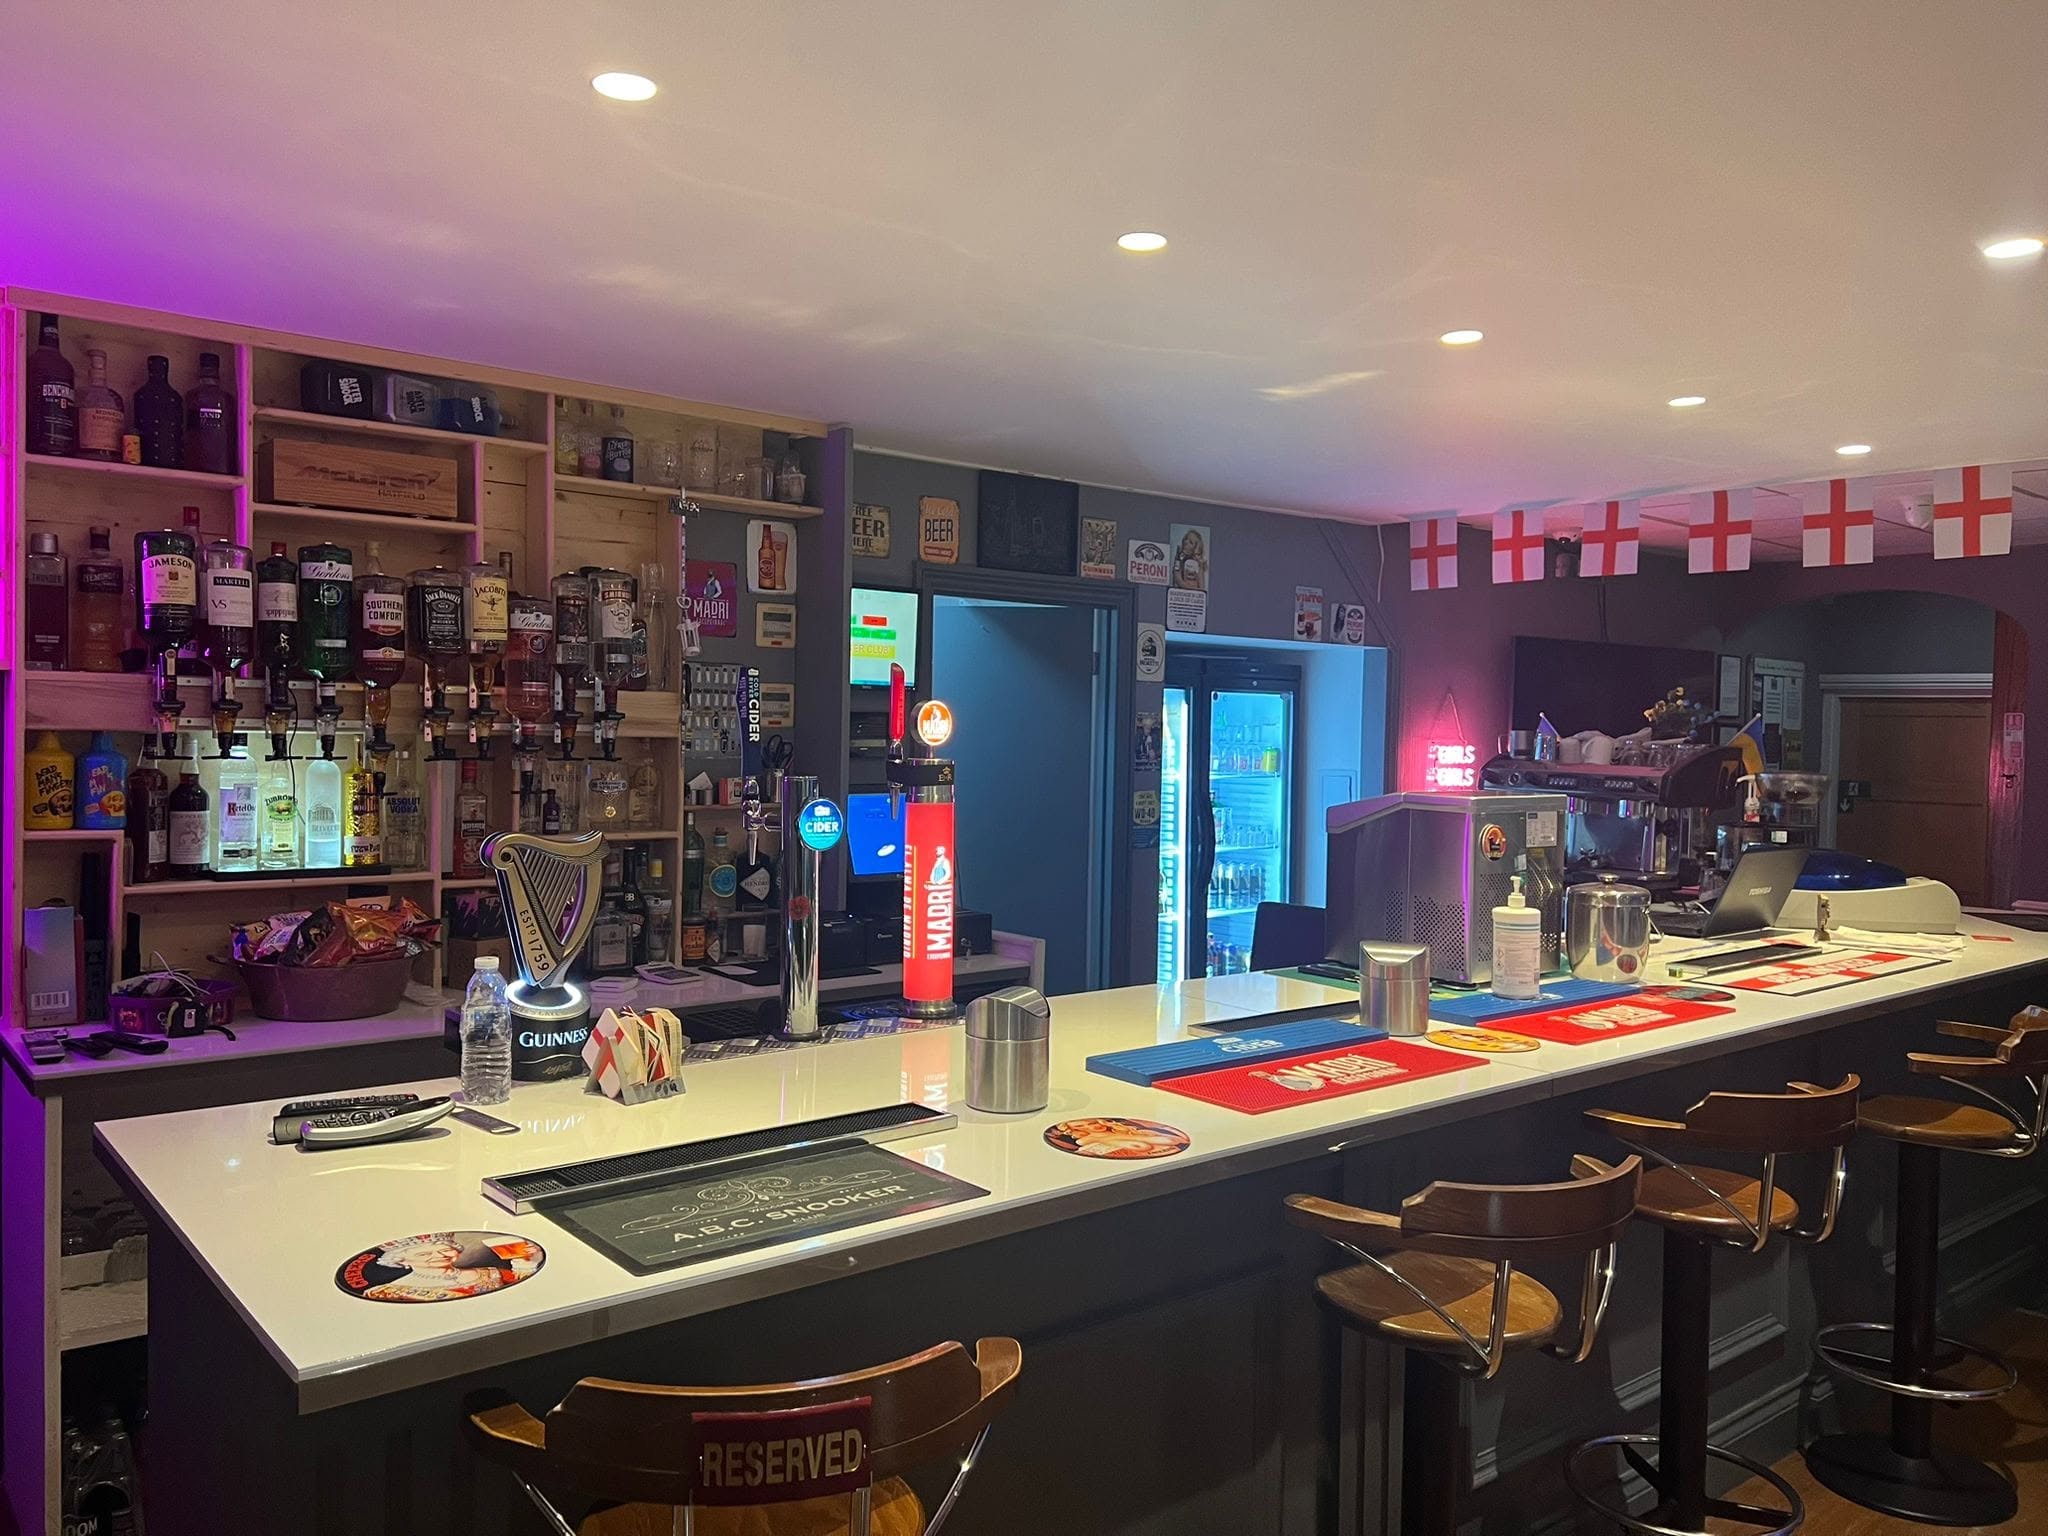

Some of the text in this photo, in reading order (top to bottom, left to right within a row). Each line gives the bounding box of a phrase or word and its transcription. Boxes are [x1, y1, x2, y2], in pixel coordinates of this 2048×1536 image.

[338, 377, 349, 406] SHOCK
[349, 377, 363, 404] AFTER
[471, 396, 484, 423] SHOCK
[852, 517, 886, 538] EER
[924, 518, 954, 543] BEER
[149, 557, 193, 571] JAMESON
[1129, 560, 1168, 578] PERONI
[211, 599, 228, 610] VS
[749, 699, 760, 742] CIDER
[805, 820, 839, 834] CIDER
[519, 1028, 588, 1048] GUINNESS
[765, 1184, 908, 1221] SNOOKER
[702, 1428, 864, 1488] RESERVED
